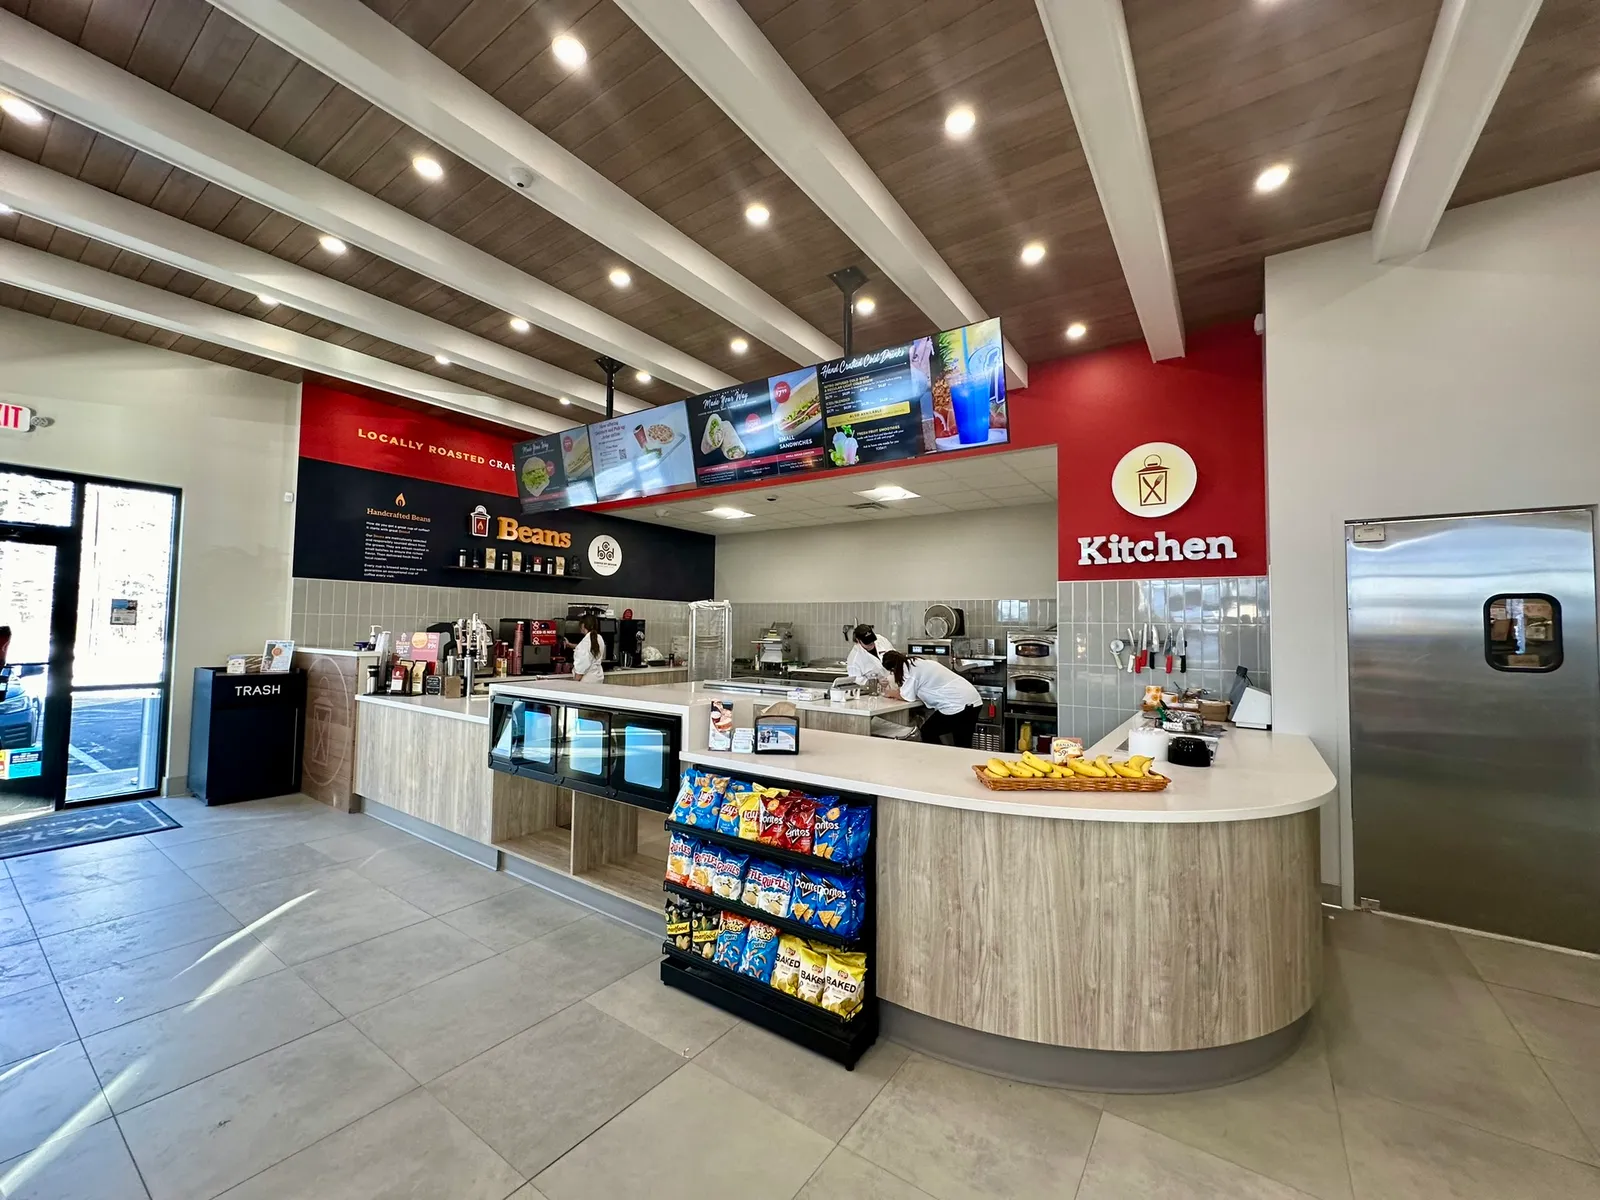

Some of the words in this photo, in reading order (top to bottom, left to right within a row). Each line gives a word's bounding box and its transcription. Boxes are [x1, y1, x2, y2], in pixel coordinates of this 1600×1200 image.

[358, 428, 424, 450] LOCALLY
[428, 445, 485, 464] ROASTED
[366, 508, 410, 520] Handcrafted
[496, 516, 572, 548] Beans
[1078, 531, 1237, 565] Kitchen
[235, 685, 280, 696] TRASH
[762, 816, 783, 825] oritos
[716, 862, 740, 875] RUFFLES
[817, 886, 847, 898] Doritos
[776, 953, 800, 968] BAKED
[826, 976, 856, 993] BAKED
